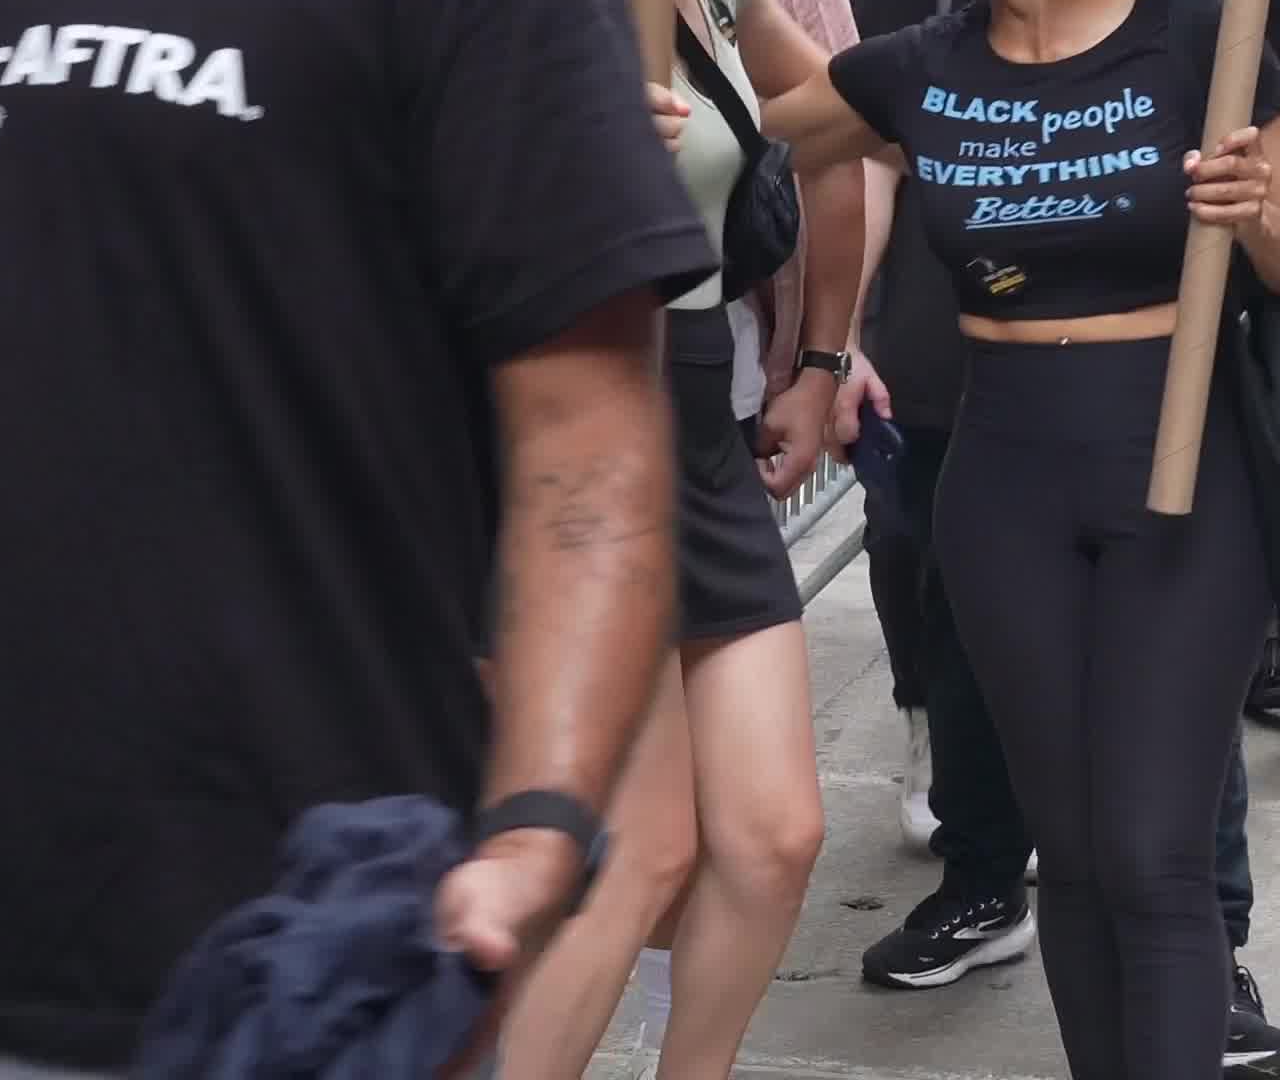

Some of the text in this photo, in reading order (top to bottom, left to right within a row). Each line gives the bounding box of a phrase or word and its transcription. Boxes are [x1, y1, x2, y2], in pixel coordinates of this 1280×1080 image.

[921, 85, 1155, 144] BLACK people
[958, 137, 1037, 158] make
[916, 145, 1160, 187] EVERYTHING
[970, 193, 1109, 223] Better
